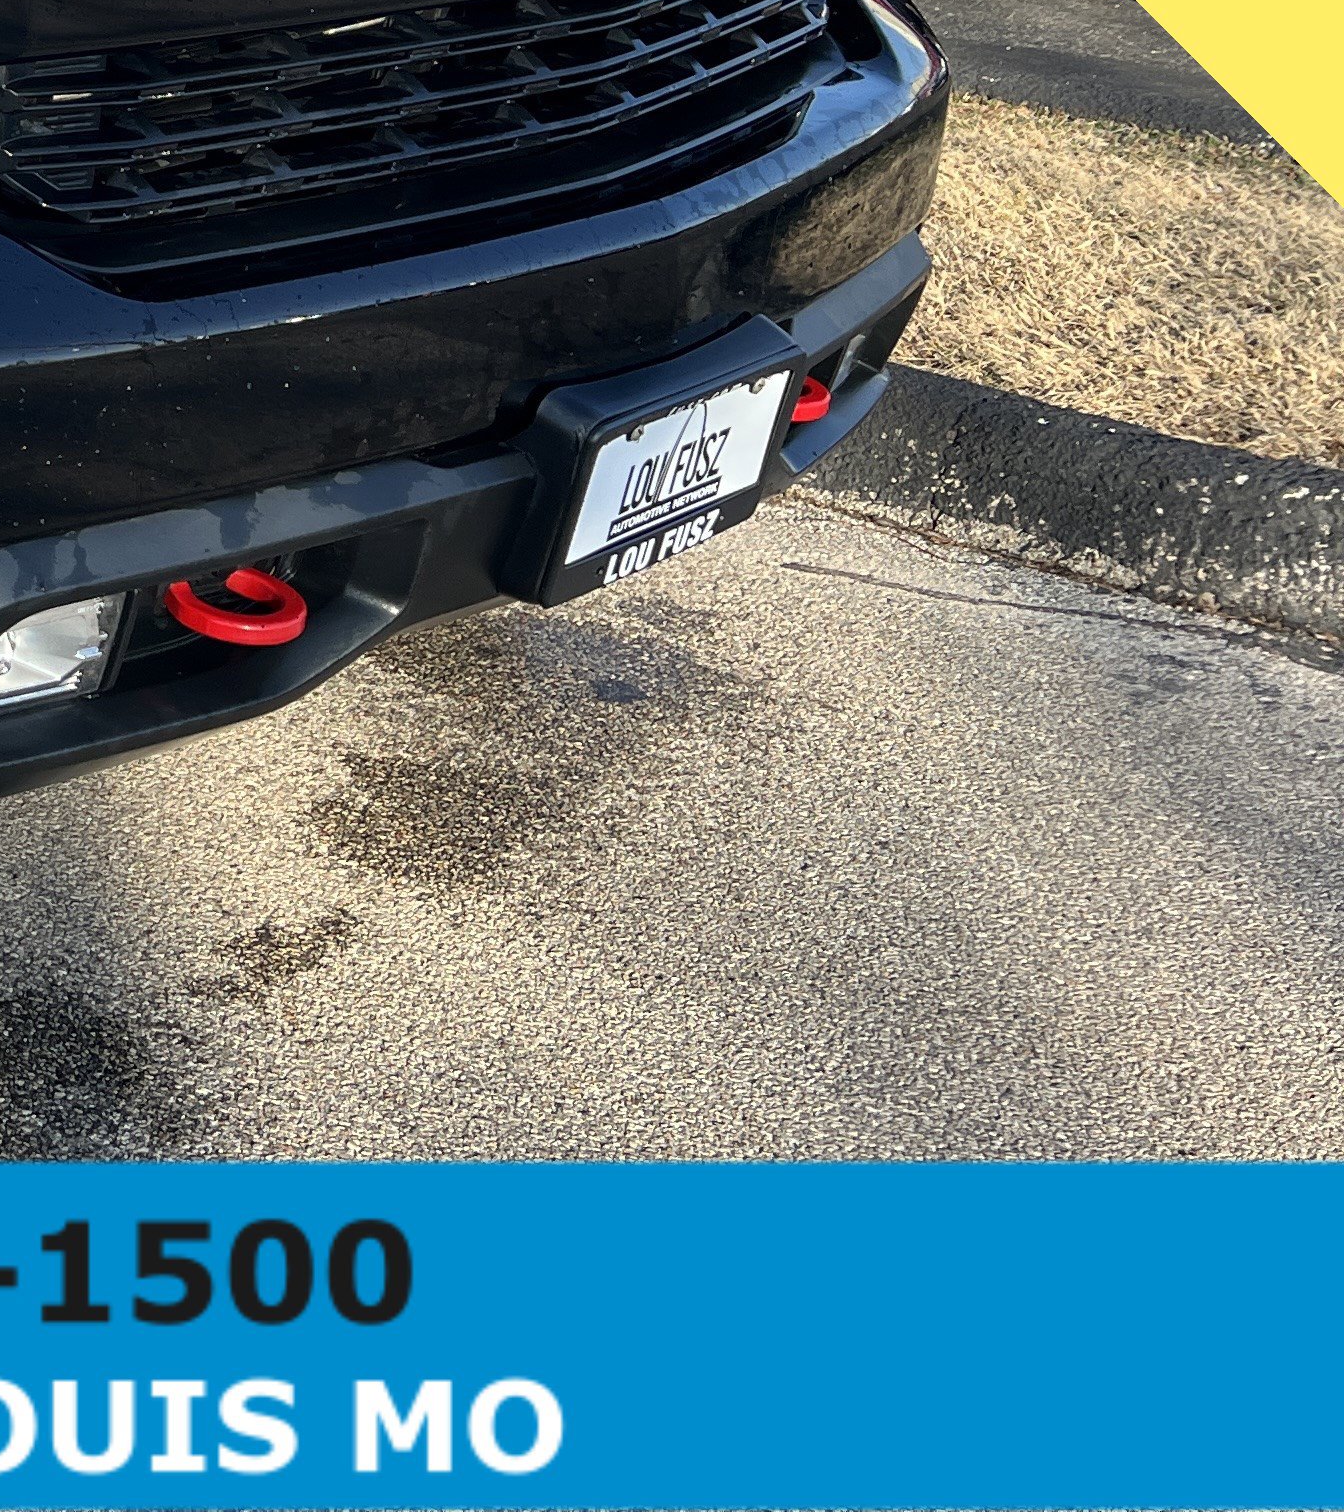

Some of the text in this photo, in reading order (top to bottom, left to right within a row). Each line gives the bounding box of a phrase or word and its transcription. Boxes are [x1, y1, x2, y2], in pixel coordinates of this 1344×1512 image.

[610, 481, 719, 537] AUTOMOTIVE NETWORK
[618, 426, 732, 516] LOU FUSZ
[603, 508, 721, 586] LOU FUSZ
